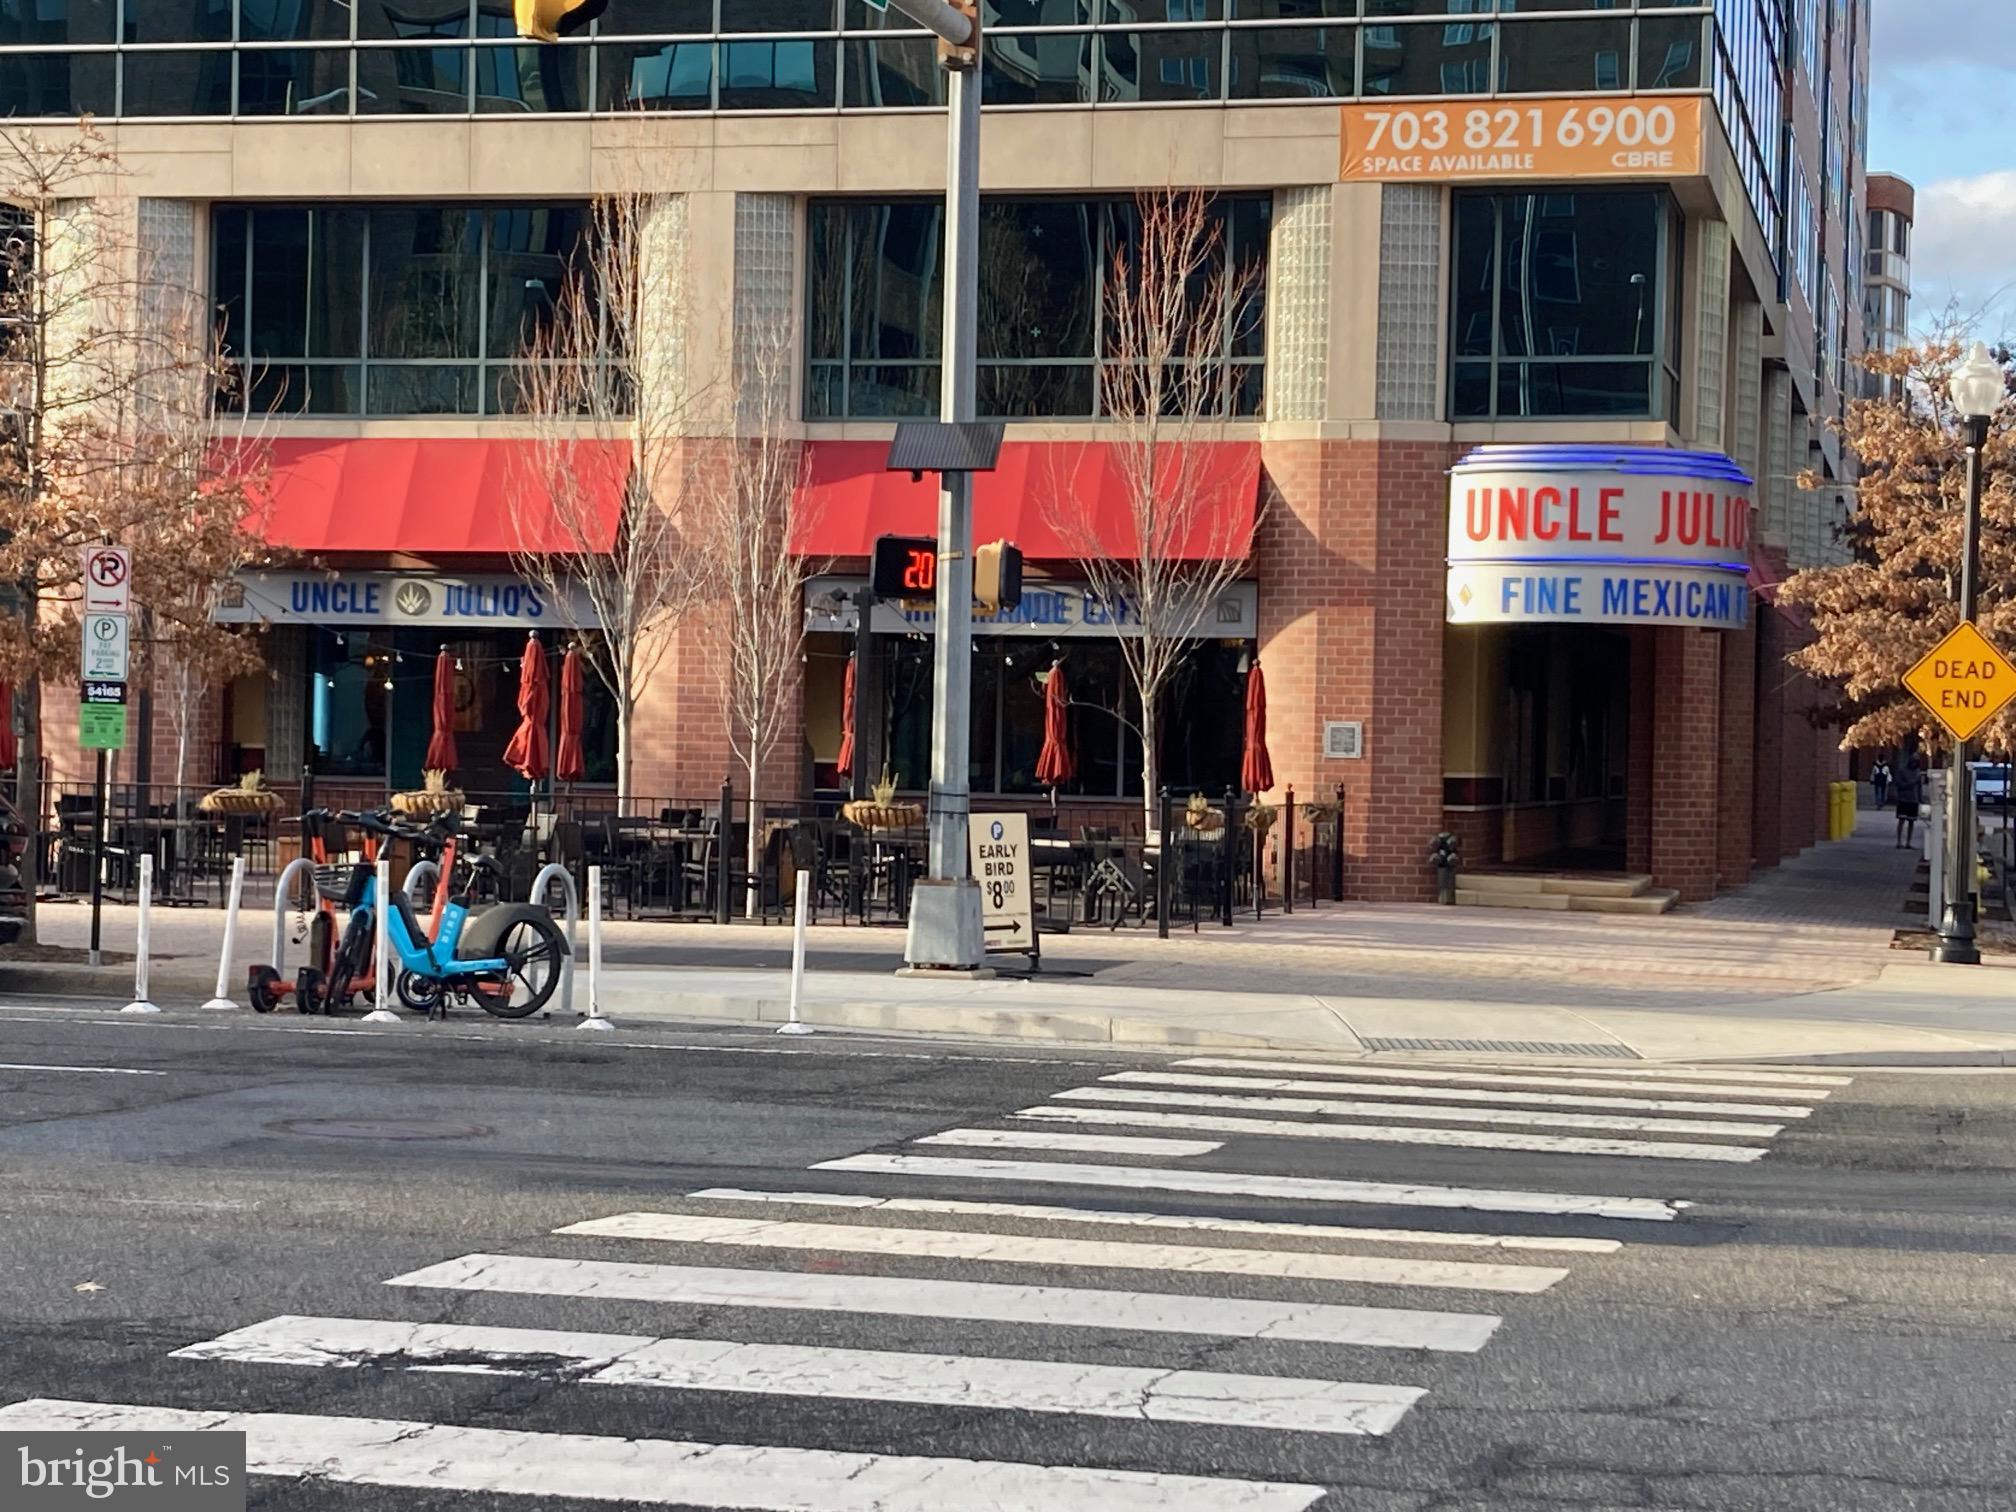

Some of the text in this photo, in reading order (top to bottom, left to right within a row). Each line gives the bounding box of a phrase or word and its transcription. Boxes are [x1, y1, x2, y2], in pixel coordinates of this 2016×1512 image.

[1363, 105, 1675, 151] 703 821 6900
[1362, 151, 1673, 173] SPACE AVAILABLE CBRE
[1466, 487, 1624, 543] UNCLE
[904, 550, 934, 590] 20
[291, 581, 544, 617] UNCLE JULIO'S
[1501, 577, 1582, 614] FINE
[1602, 577, 1730, 621] MEXICAN
[1935, 660, 1996, 679] DEAD
[1941, 690, 1987, 708] END
[979, 844, 1018, 859] EARLY
[985, 862, 1014, 876] BIRD
[441, 910, 458, 944] BIRD
